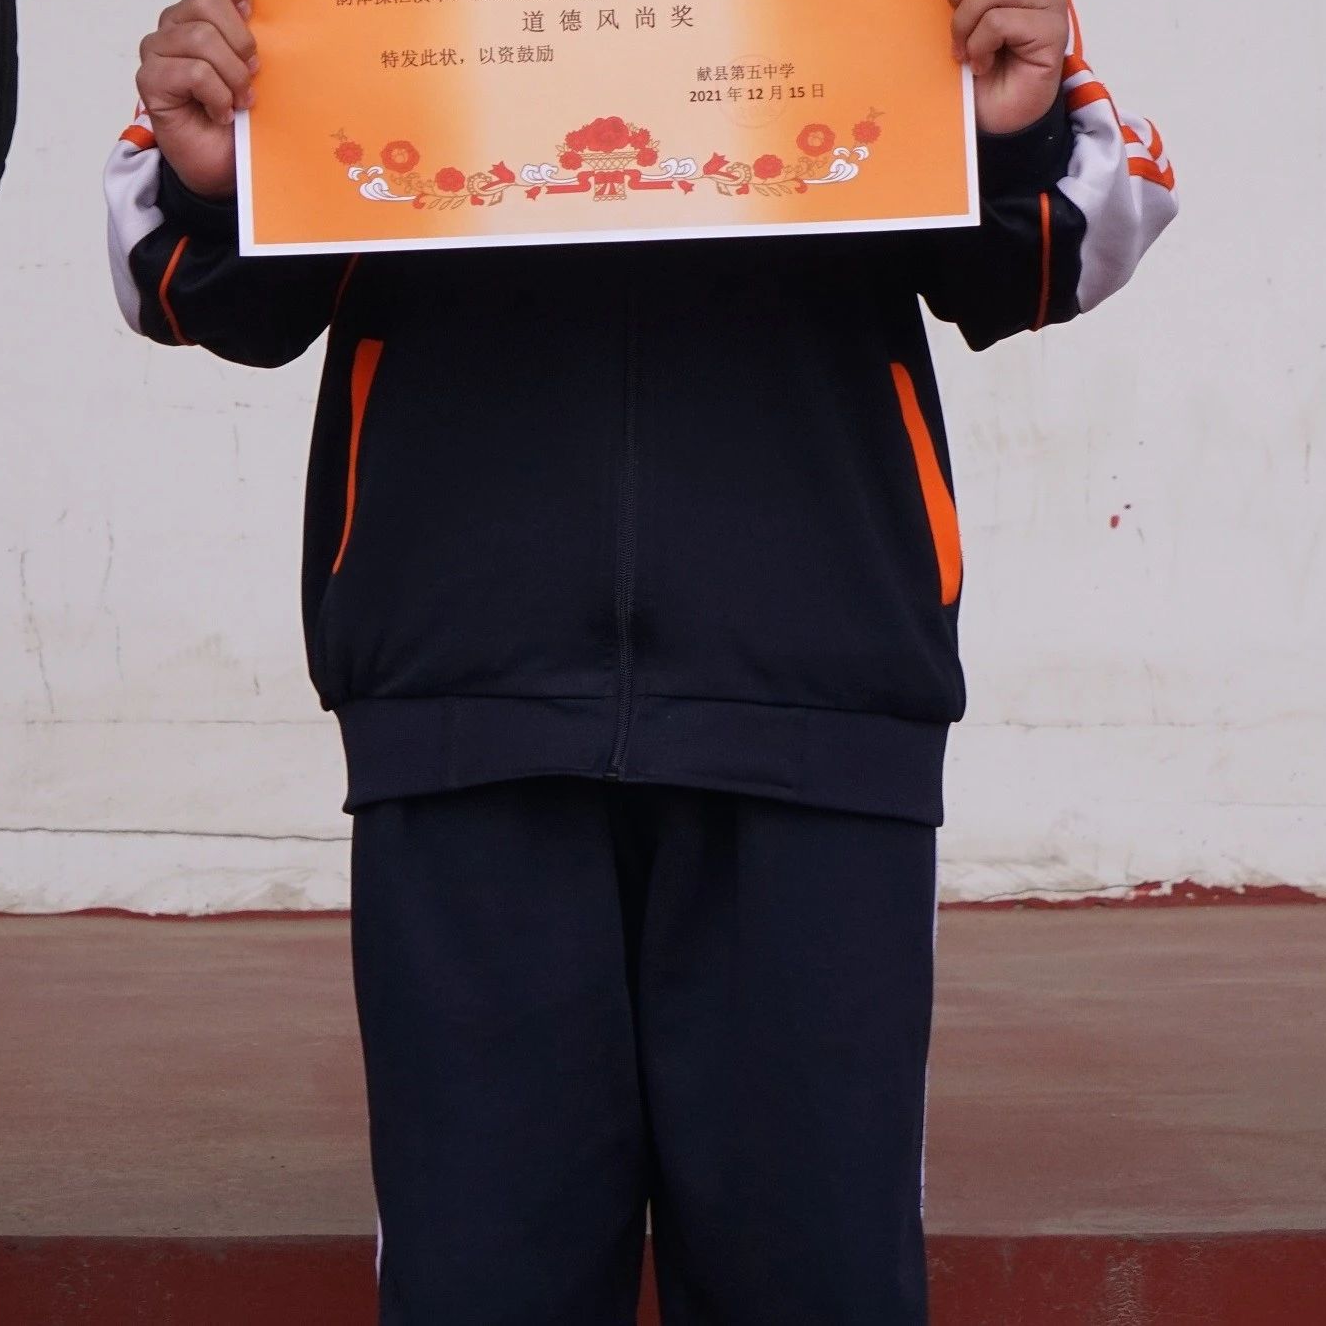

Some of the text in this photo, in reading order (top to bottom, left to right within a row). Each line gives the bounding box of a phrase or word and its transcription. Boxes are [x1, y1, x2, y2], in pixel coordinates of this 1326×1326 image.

[695, 62, 796, 82] 献县第五中学
